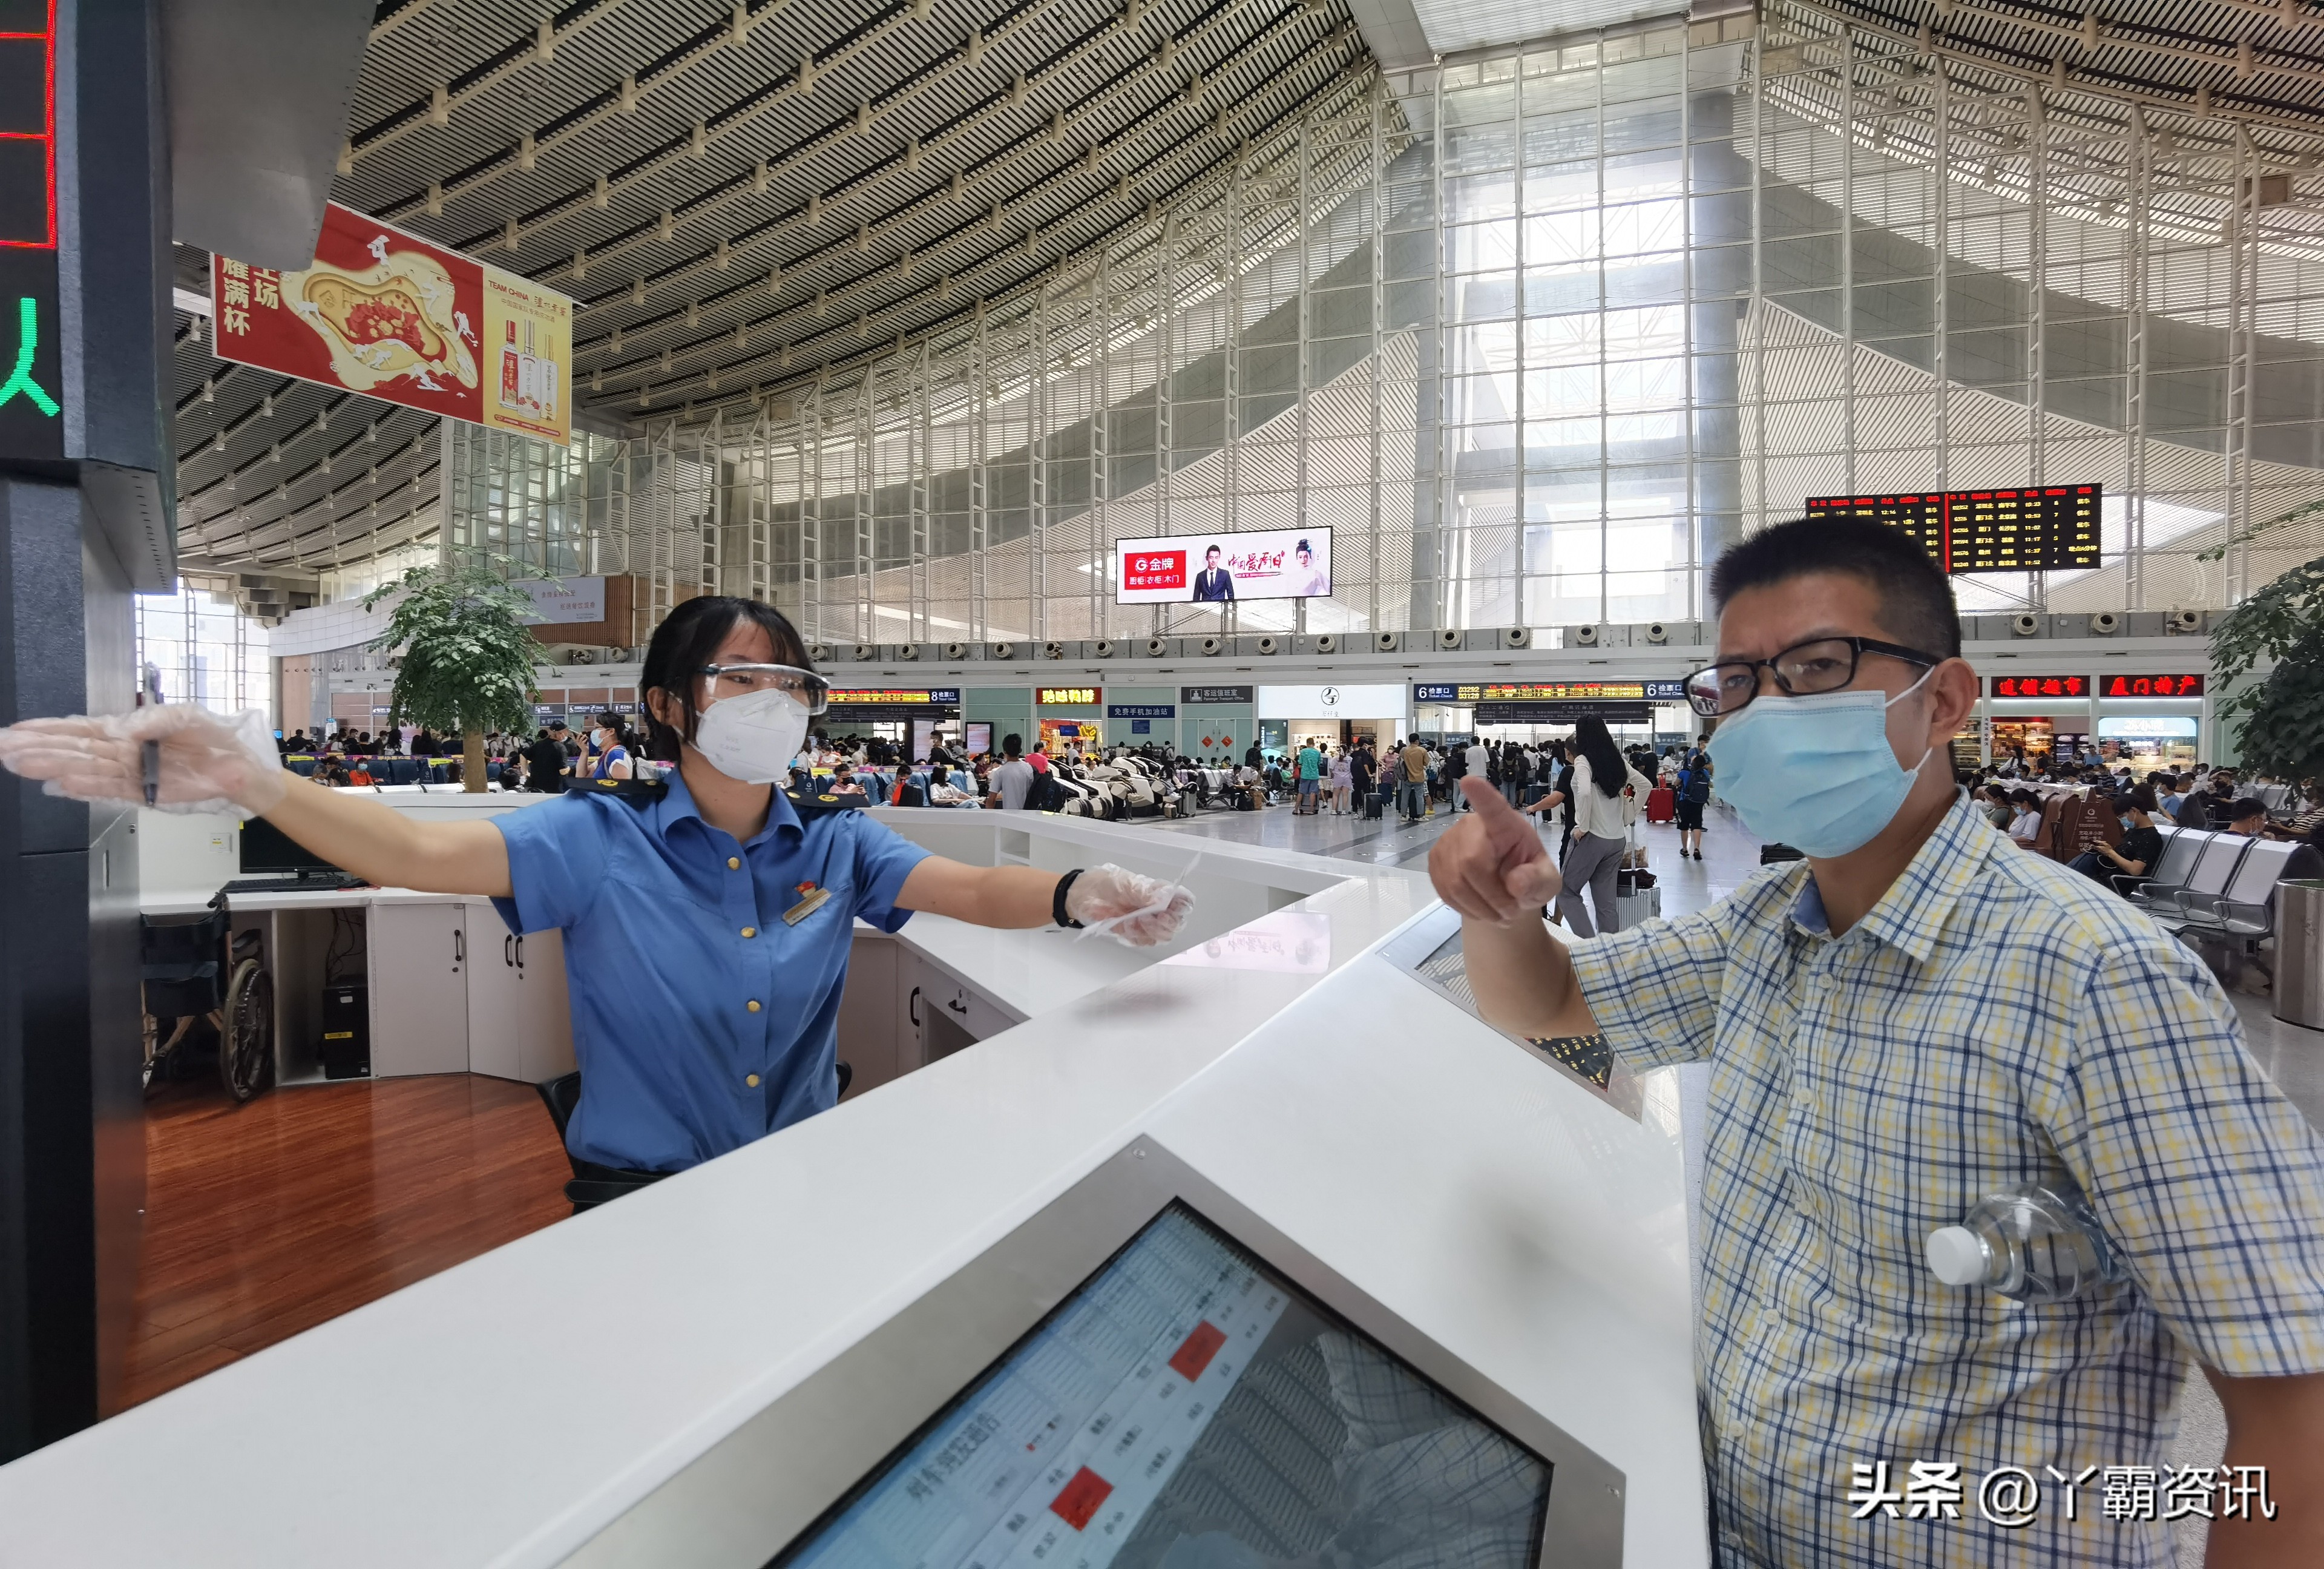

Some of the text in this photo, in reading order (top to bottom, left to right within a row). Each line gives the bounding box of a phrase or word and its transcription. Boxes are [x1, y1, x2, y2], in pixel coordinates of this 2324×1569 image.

[488, 280, 529, 301] TEAM CHINA
[1149, 558, 1174, 571] 金牌
[931, 691, 937, 701] 8
[1419, 687, 1427, 699] 6
[1647, 684, 1657, 696] 6
